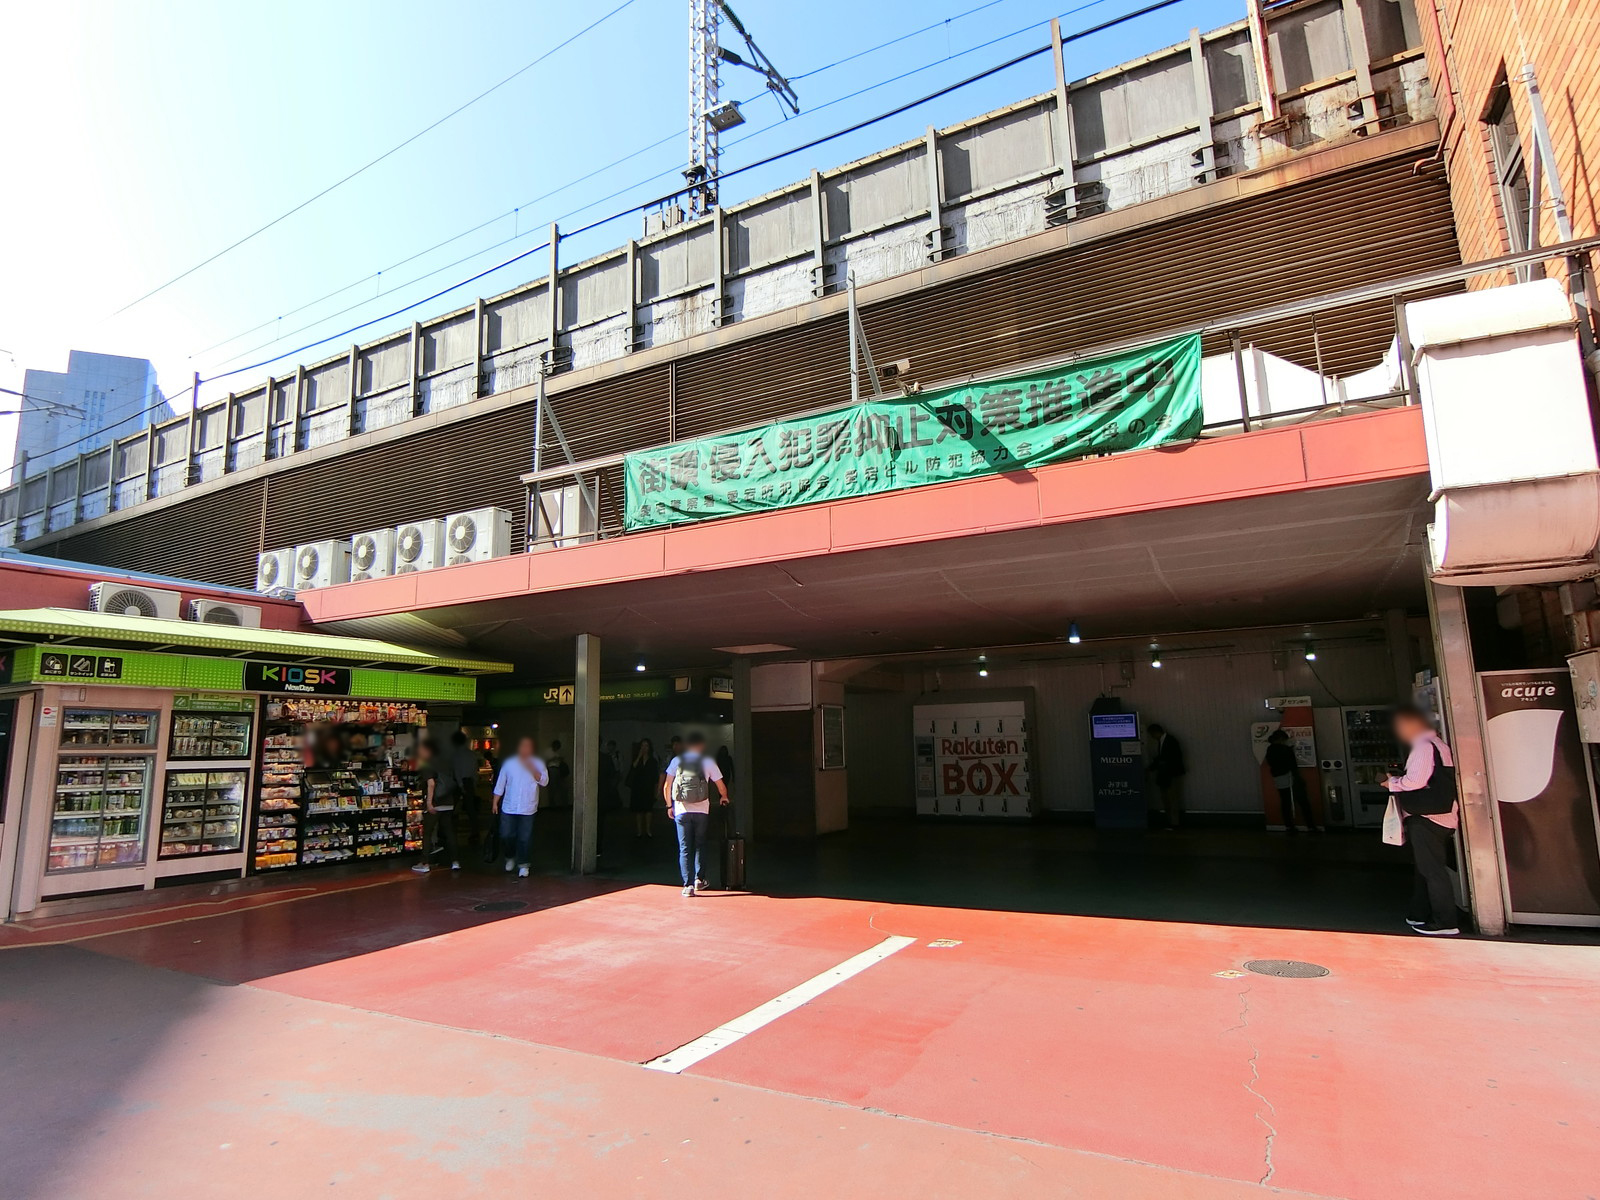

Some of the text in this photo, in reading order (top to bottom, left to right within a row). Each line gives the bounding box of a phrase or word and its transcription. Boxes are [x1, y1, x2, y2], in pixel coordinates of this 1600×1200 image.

[262, 665, 337, 685] KIOSK
[284, 684, 315, 692] NewDays
[543, 688, 559, 700] JR
[1501, 686, 1556, 698] acure
[941, 737, 1019, 755] Rakuten
[1100, 756, 1133, 764] MIZUHO
[942, 763, 1020, 796] BOX
